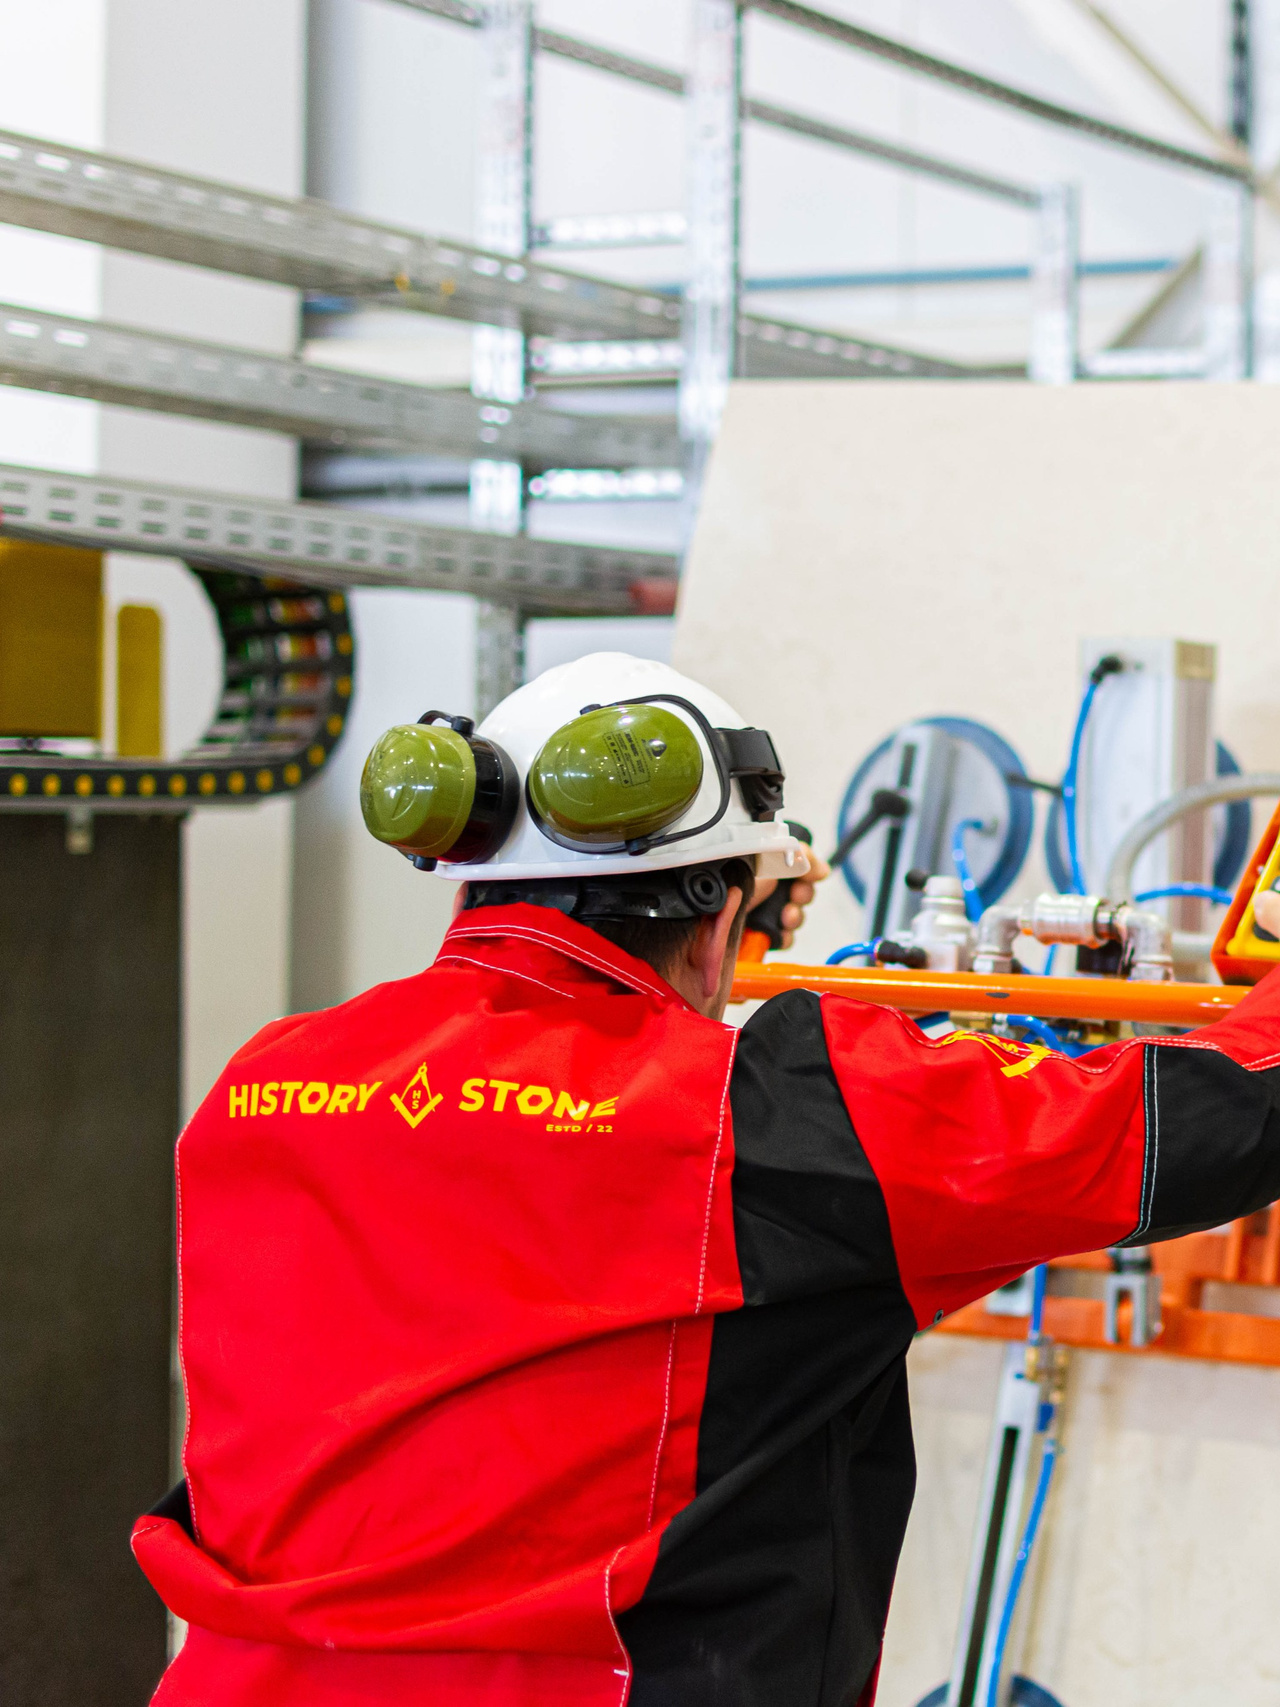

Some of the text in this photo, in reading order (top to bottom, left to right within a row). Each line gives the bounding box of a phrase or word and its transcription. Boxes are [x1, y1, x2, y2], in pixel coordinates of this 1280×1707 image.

[230, 1078, 619, 1121] HISTORY STONE
[545, 1123, 582, 1133] ESTD
[596, 1124, 613, 1133] 22
